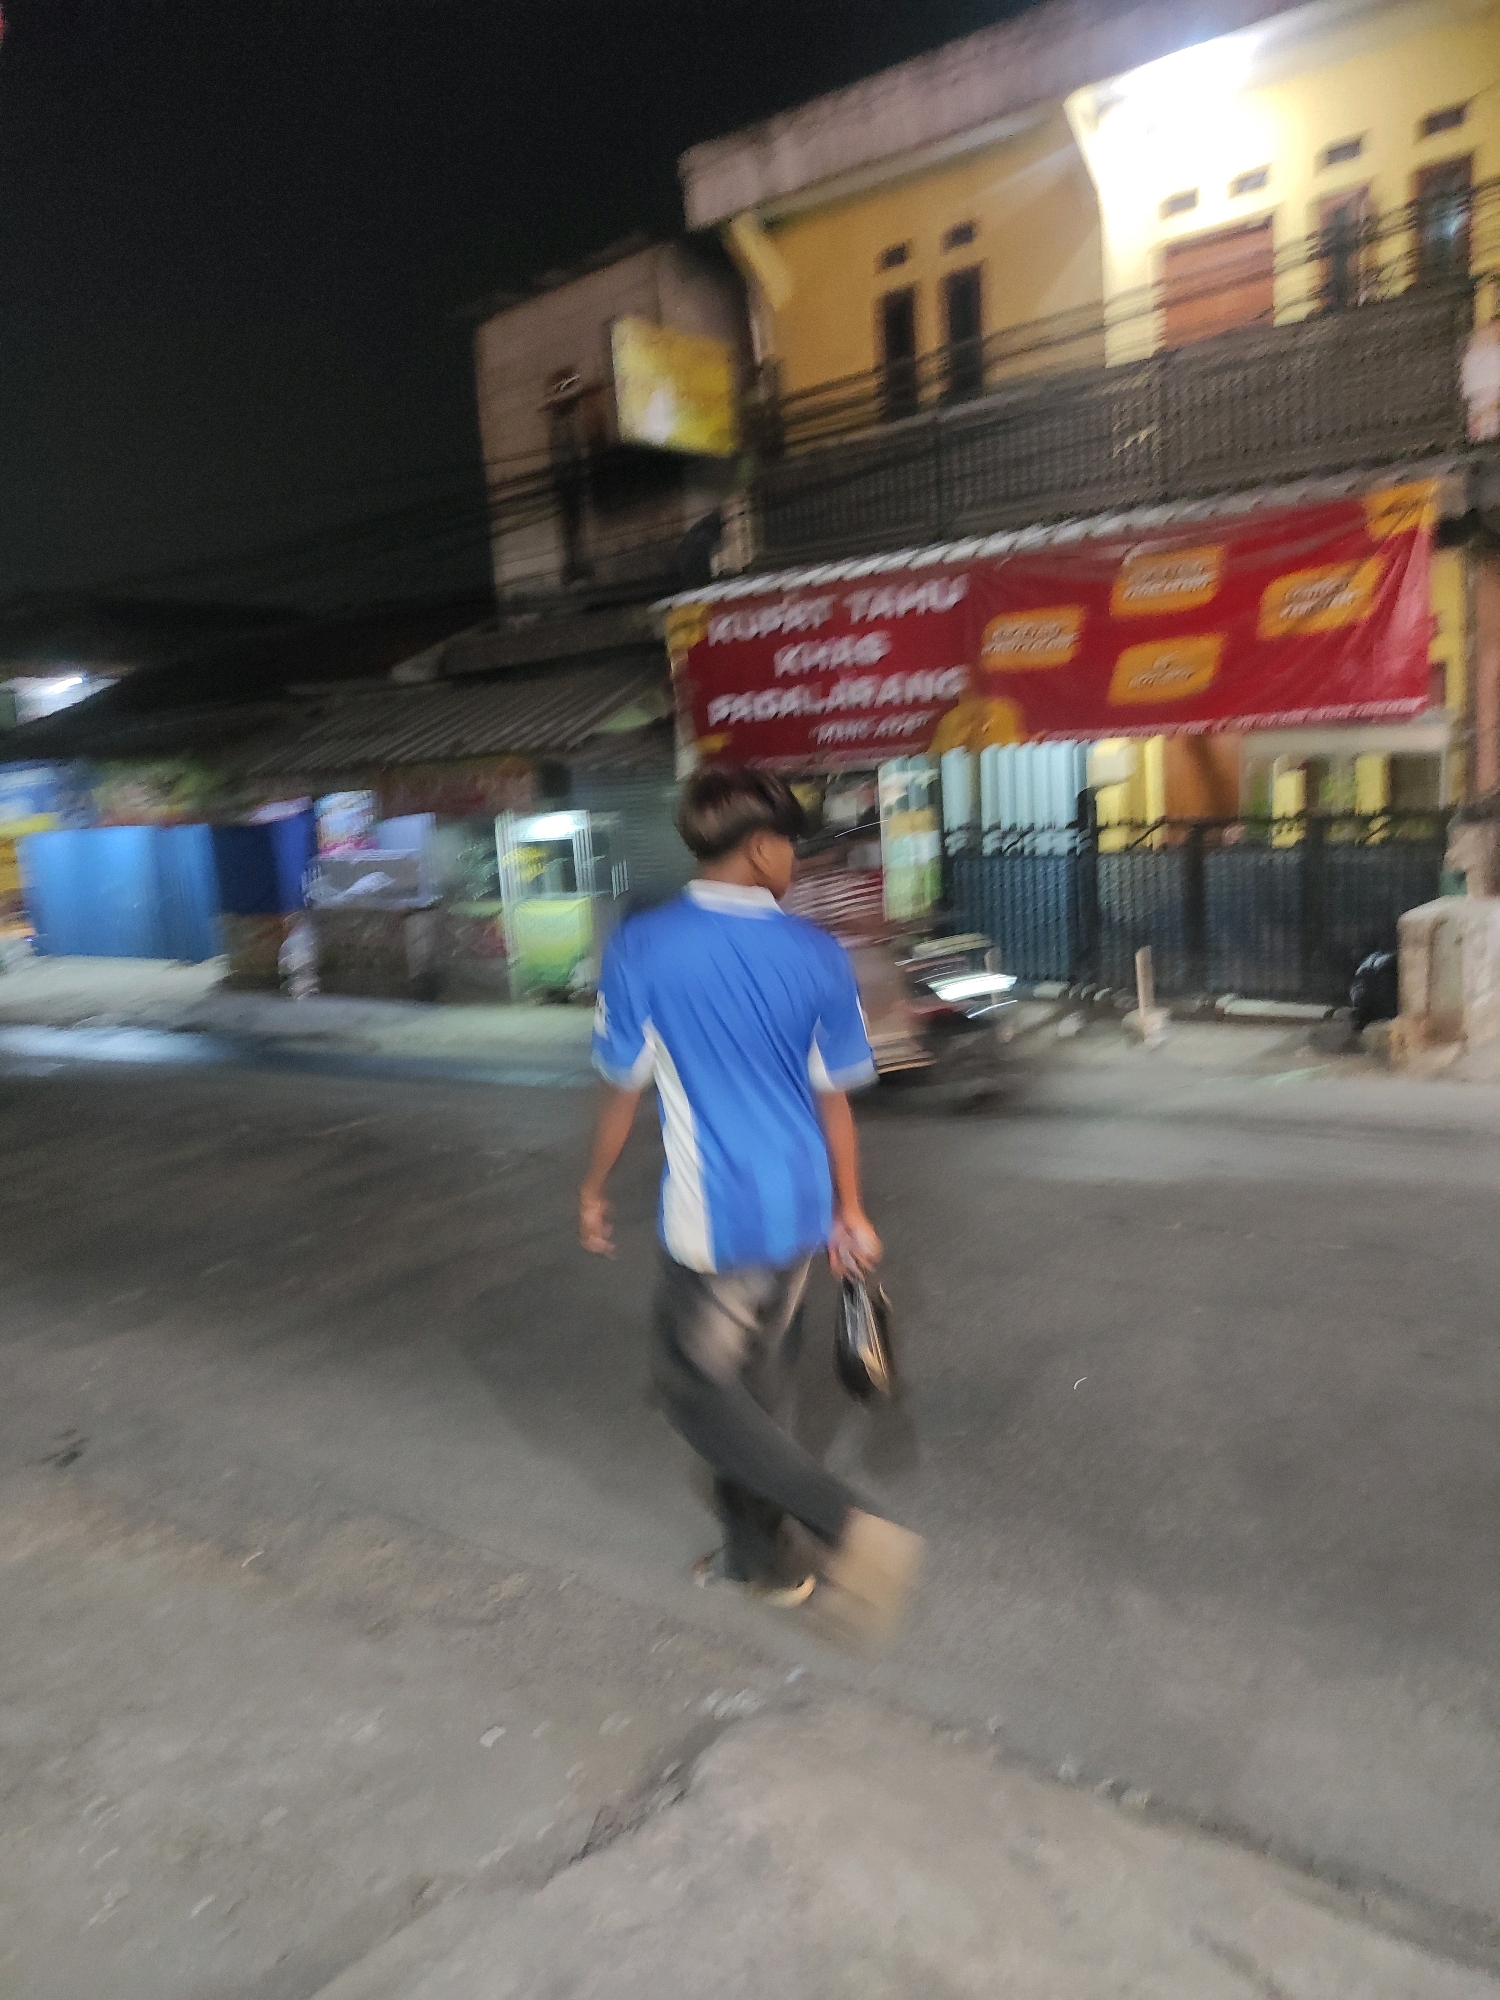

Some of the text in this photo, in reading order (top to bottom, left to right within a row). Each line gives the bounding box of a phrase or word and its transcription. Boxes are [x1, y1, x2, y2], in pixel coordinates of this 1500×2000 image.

[707, 574, 969, 646] KUPAT TAHU
[774, 631, 892, 678] KHAS
